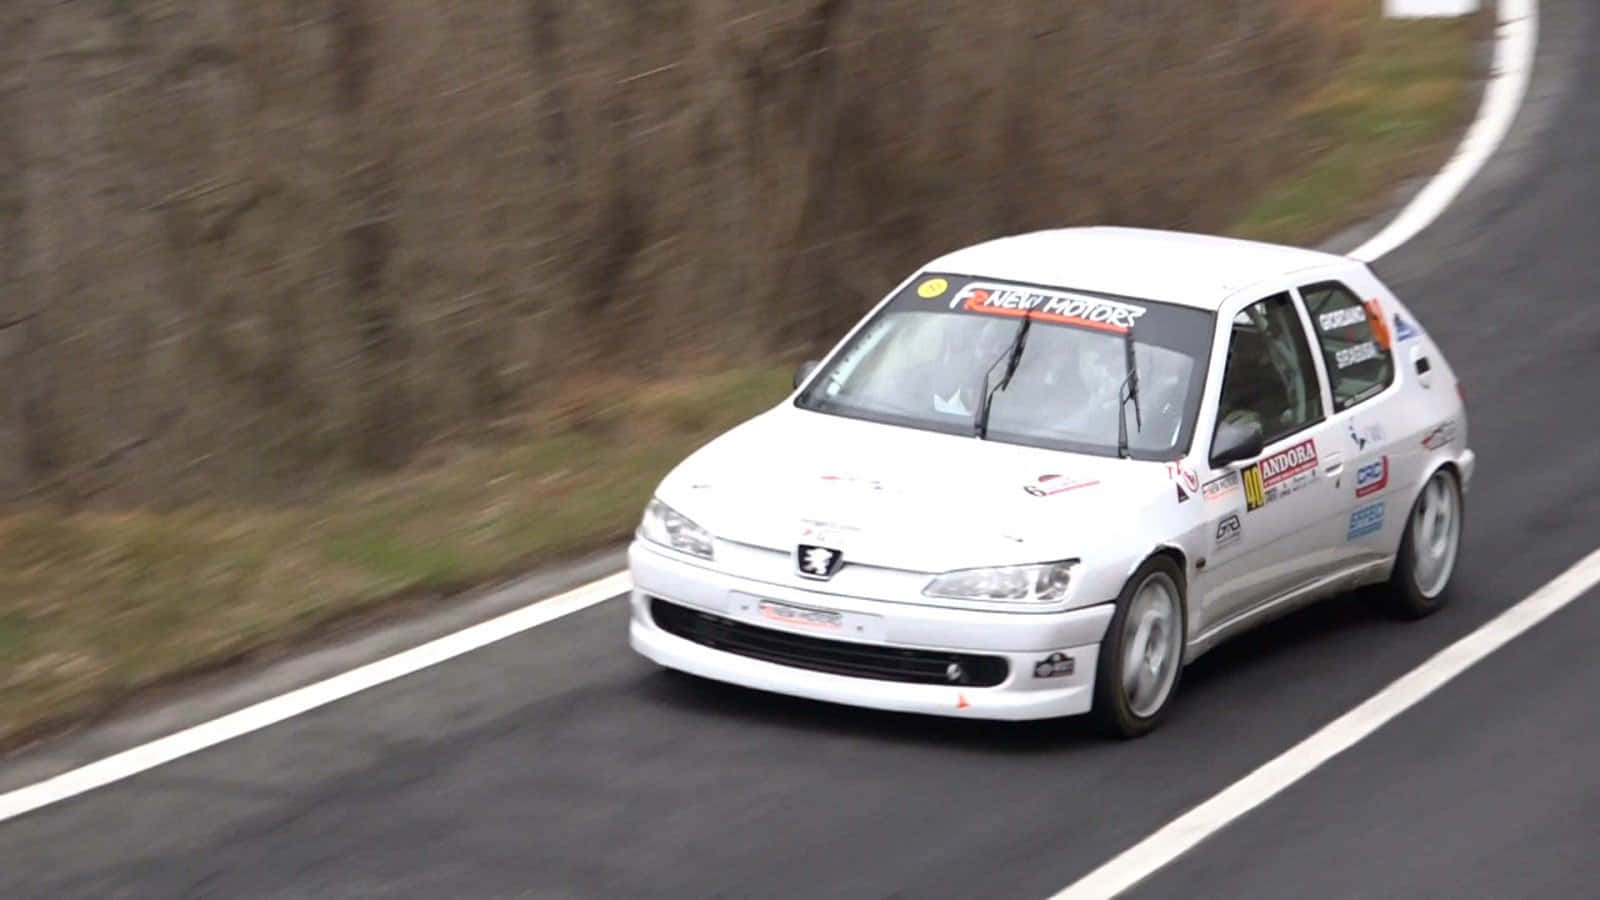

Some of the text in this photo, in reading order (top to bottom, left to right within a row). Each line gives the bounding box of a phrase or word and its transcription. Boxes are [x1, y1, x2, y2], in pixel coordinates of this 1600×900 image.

[984, 288, 1040, 310] NEW
[1043, 298, 1146, 327] MOTORS
[1262, 442, 1315, 479] ANDORA
